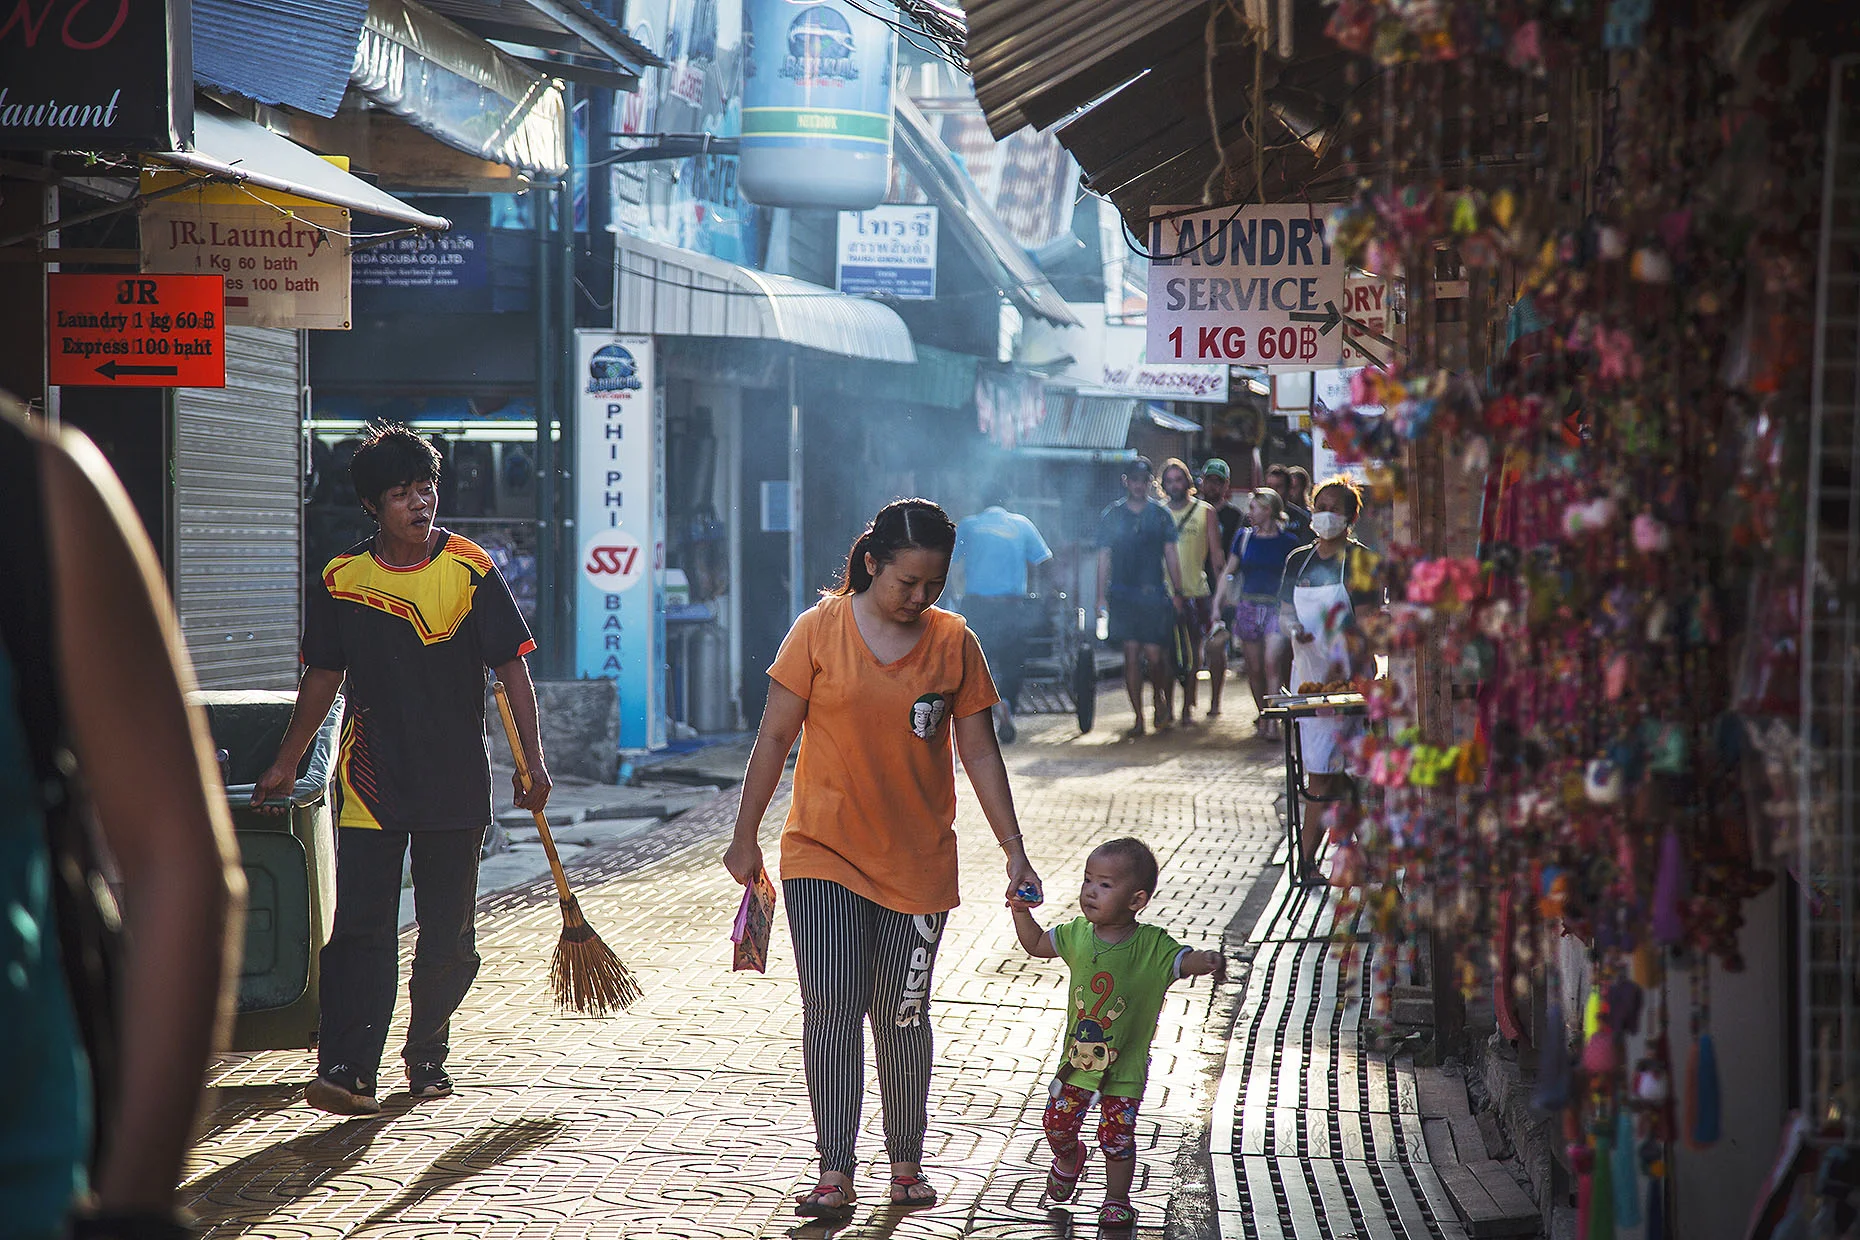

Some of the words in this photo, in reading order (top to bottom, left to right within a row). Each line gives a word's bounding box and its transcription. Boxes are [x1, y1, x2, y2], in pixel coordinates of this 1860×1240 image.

[0, 88, 121, 128] aurant
[1152, 218, 1332, 266] LAUNDRY
[210, 255, 231, 272] Kg
[239, 257, 256, 270] 60
[264, 256, 298, 271] bath
[351, 254, 379, 265] KUDA
[380, 254, 418, 265] SCUBA
[117, 279, 159, 305] JR
[253, 278, 277, 291] 100
[285, 277, 319, 292] bath
[1166, 277, 1319, 311] SERVICE
[1343, 284, 1385, 314] DRY
[57, 310, 128, 333] Laundry
[134, 312, 143, 328] 1
[150, 311, 171, 333] kg
[62, 337, 129, 359] Express
[135, 338, 169, 355] 100
[174, 338, 213, 356] baht
[1168, 326, 1182, 359] 1
[1198, 326, 1246, 359] KG
[1103, 364, 1133, 384] hai
[1137, 372, 1222, 395] massage
[586, 545, 638, 576] SSI
[603, 593, 623, 679] BARA
[896, 946, 931, 1028] asics
